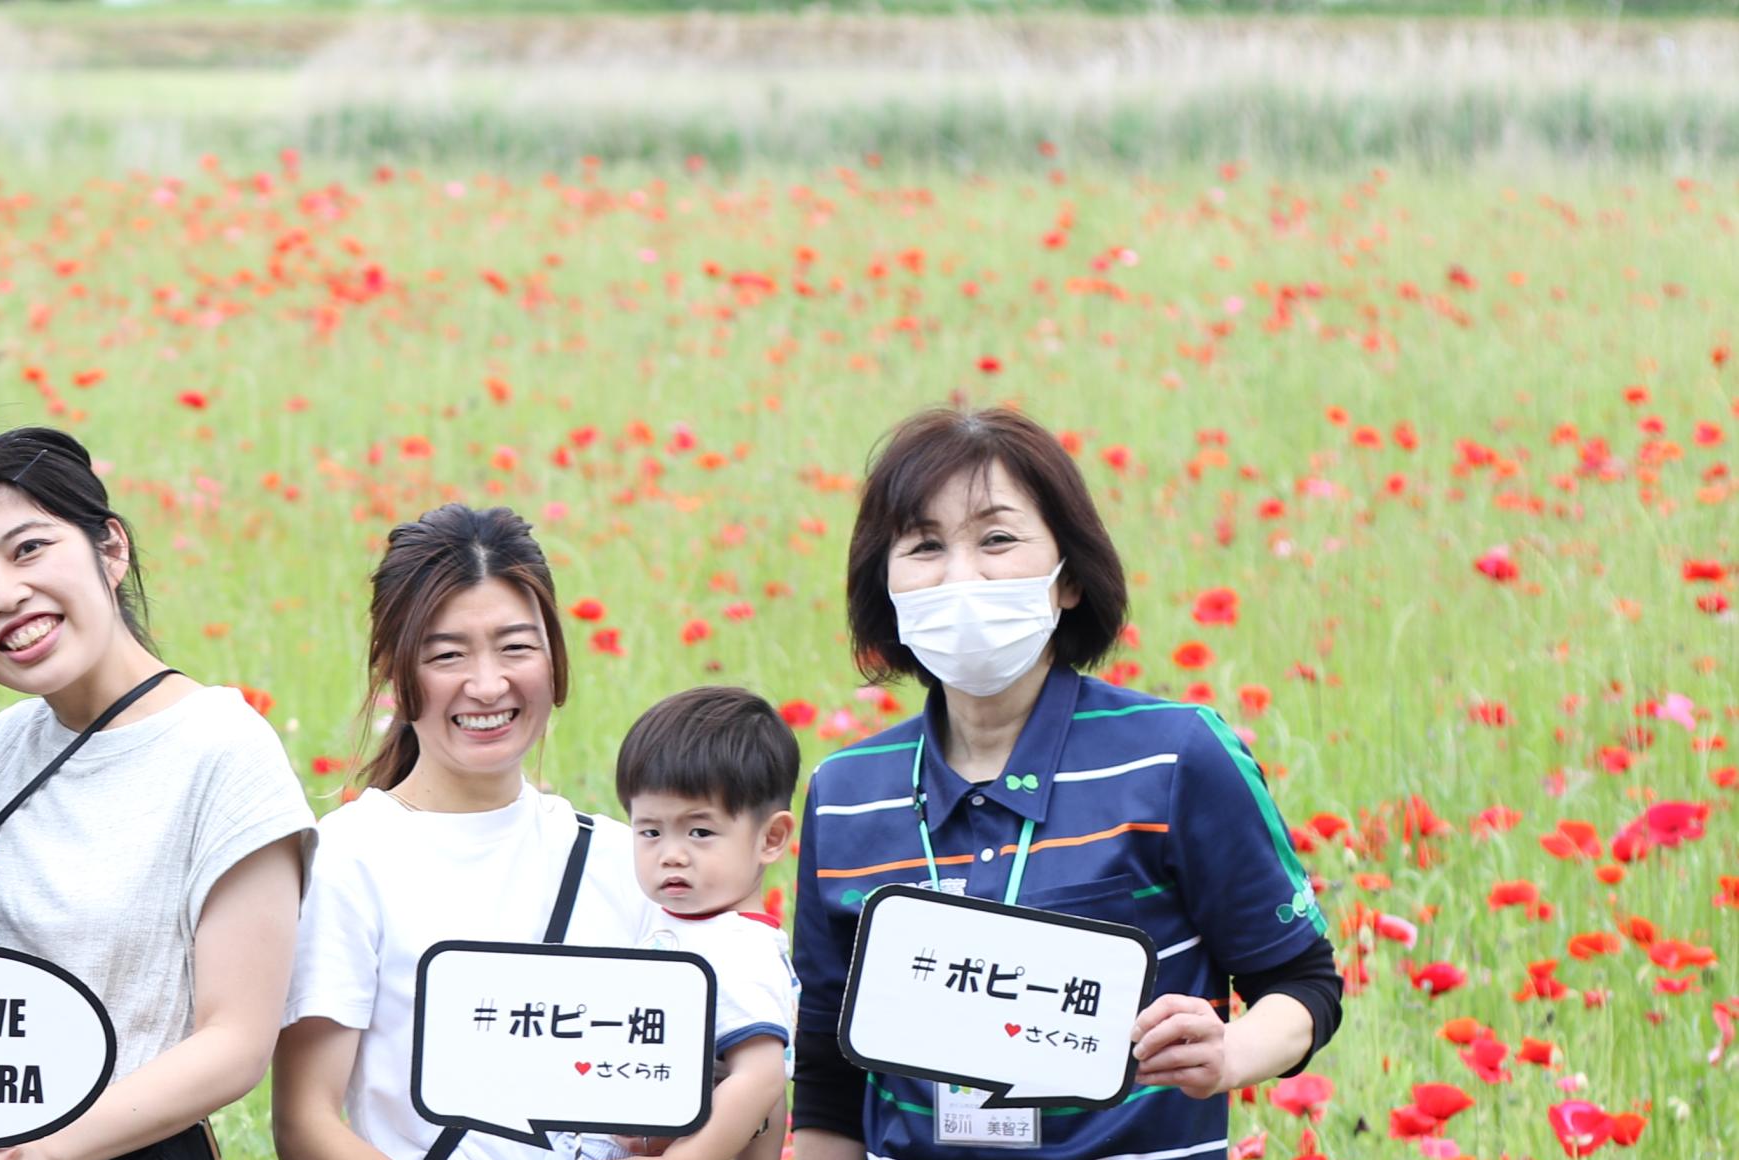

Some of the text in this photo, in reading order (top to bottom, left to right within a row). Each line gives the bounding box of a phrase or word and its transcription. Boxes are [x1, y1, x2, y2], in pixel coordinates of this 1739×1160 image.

[1025, 1025, 1098, 1054] さくら市
[596, 1061, 671, 1082] さくら市
